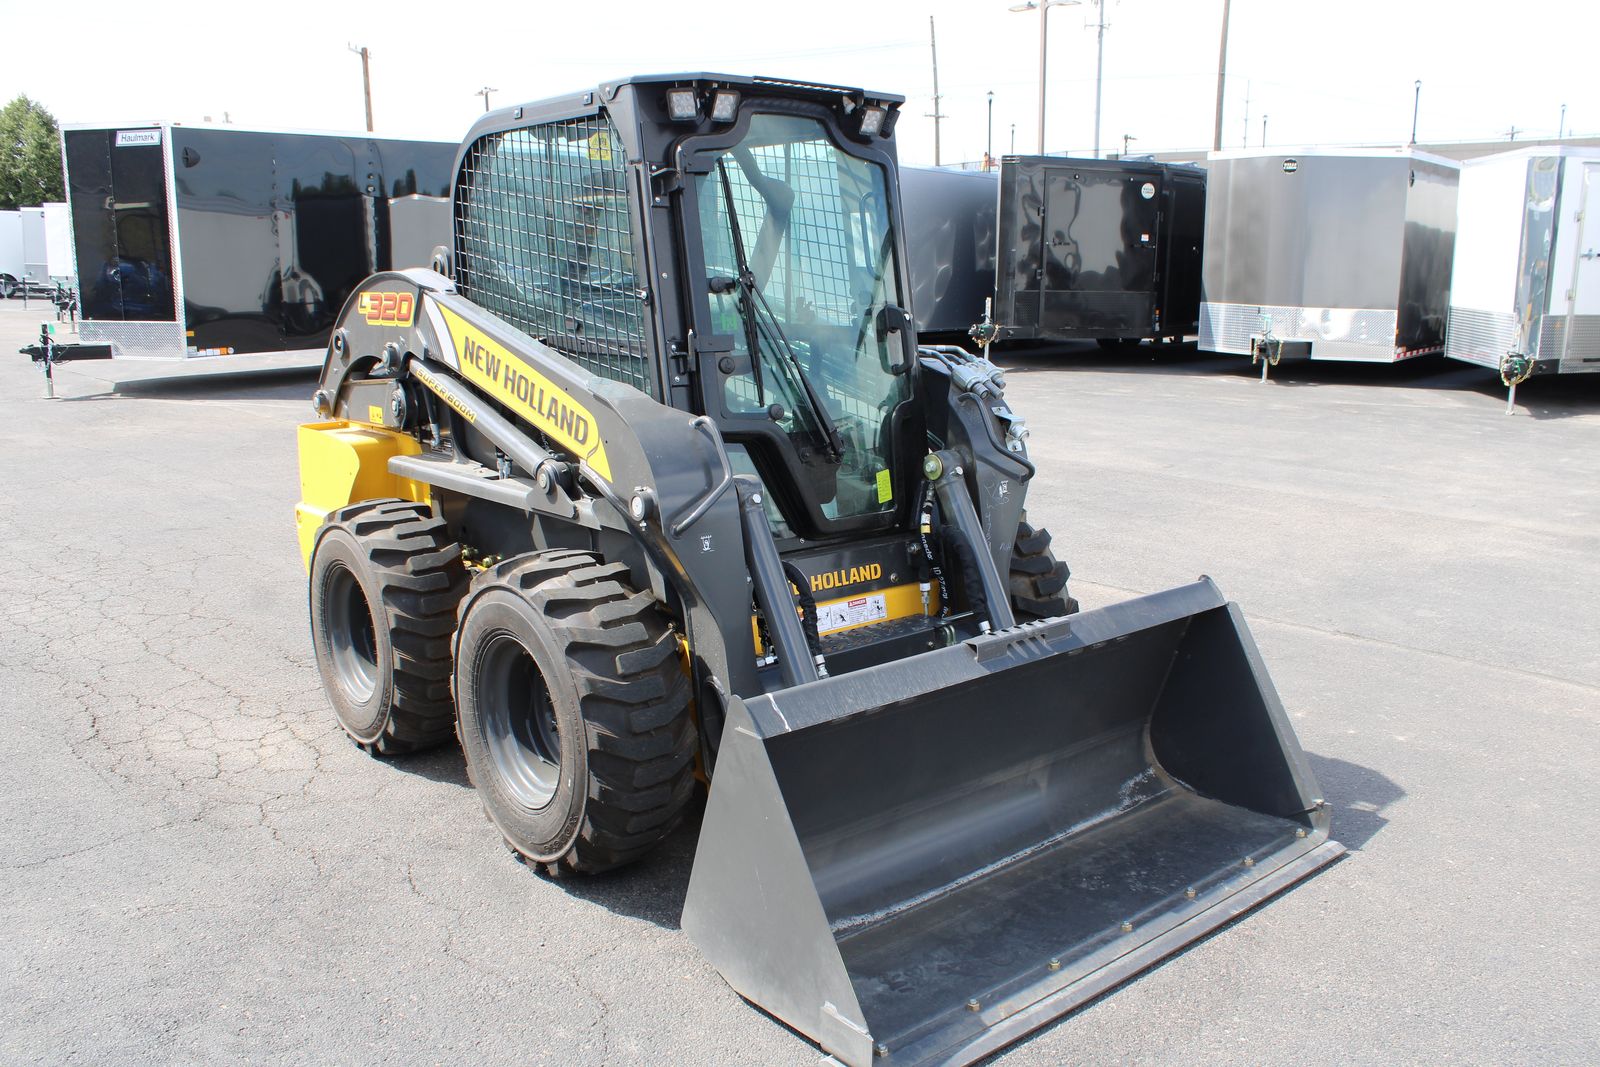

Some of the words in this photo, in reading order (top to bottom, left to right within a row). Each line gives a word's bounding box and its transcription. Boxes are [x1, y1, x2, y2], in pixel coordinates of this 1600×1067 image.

[121, 133, 155, 142] Haulmark
[359, 293, 413, 322] L320
[417, 369, 447, 396] SUPER
[447, 394, 476, 421] BOOM
[463, 335, 501, 382] NEW
[503, 364, 589, 446] HOLLAND
[810, 563, 882, 592] HOLLAND
